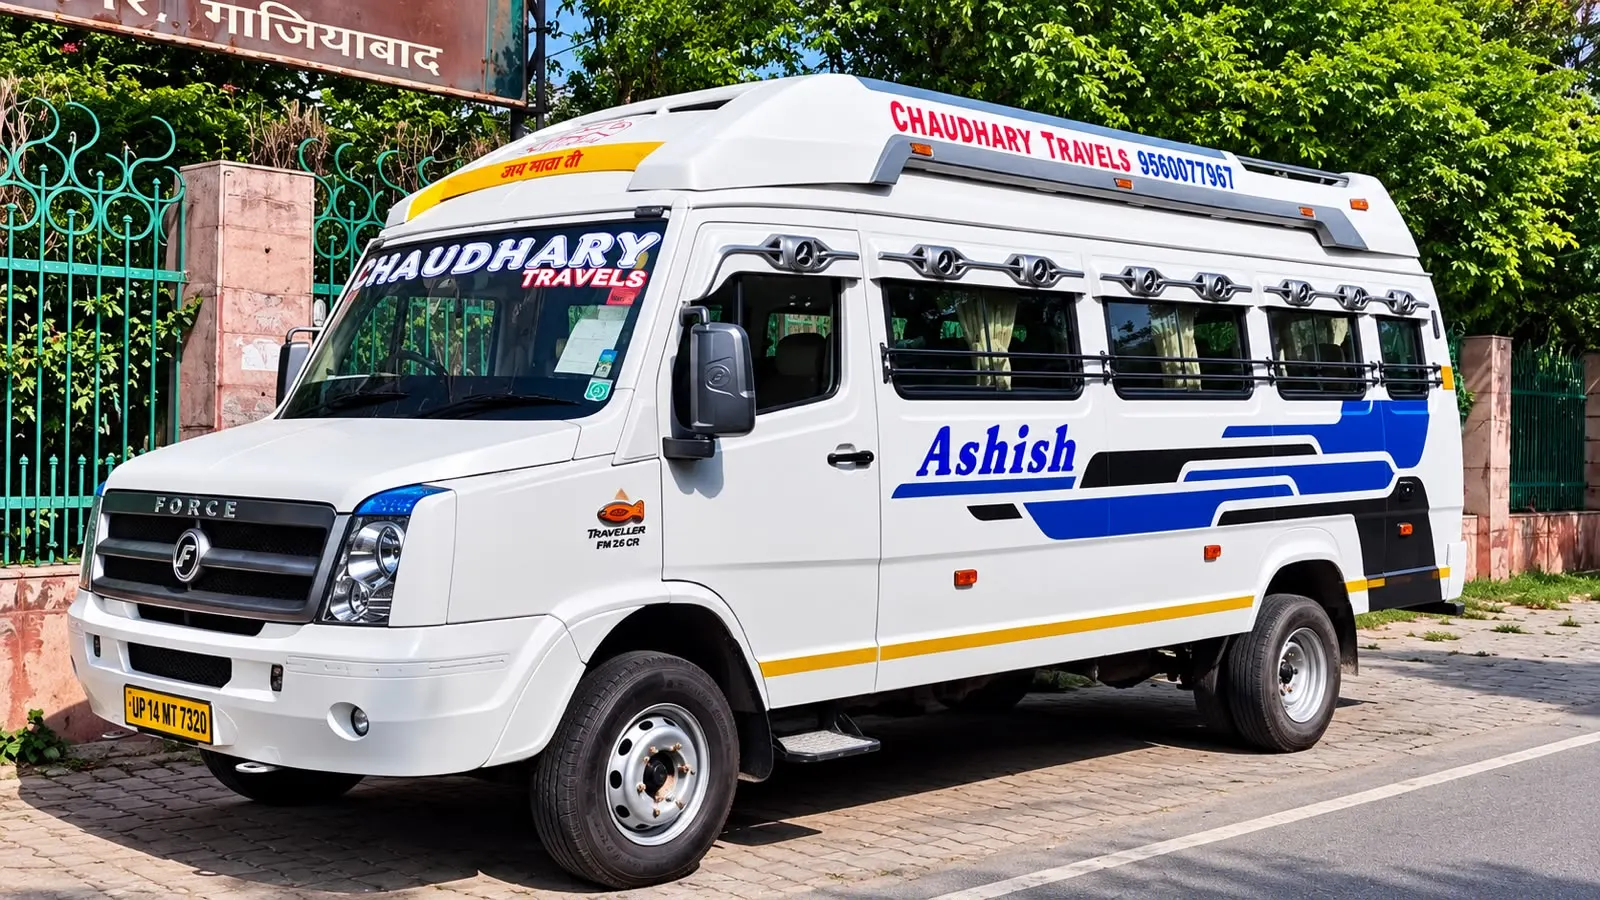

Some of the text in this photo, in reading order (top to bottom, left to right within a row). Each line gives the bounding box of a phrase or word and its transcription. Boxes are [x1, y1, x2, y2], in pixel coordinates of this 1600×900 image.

[201, 0, 444, 76] गाजियाबाद
[890, 100, 1235, 190] CHAUDHARY TRAVELS 9560077967
[353, 231, 661, 291] CHAUDHARY
[521, 267, 648, 288] TRAVELS
[916, 424, 1076, 476] Ashish
[154, 496, 237, 519] FORCE
[587, 526, 645, 539] TRAVELLER
[596, 537, 640, 549] FM 26 CR
[176, 544, 196, 568] F
[132, 696, 146, 719] UP
[148, 699, 160, 723] 14
[162, 702, 177, 727] MT
[180, 706, 207, 734] 7320
